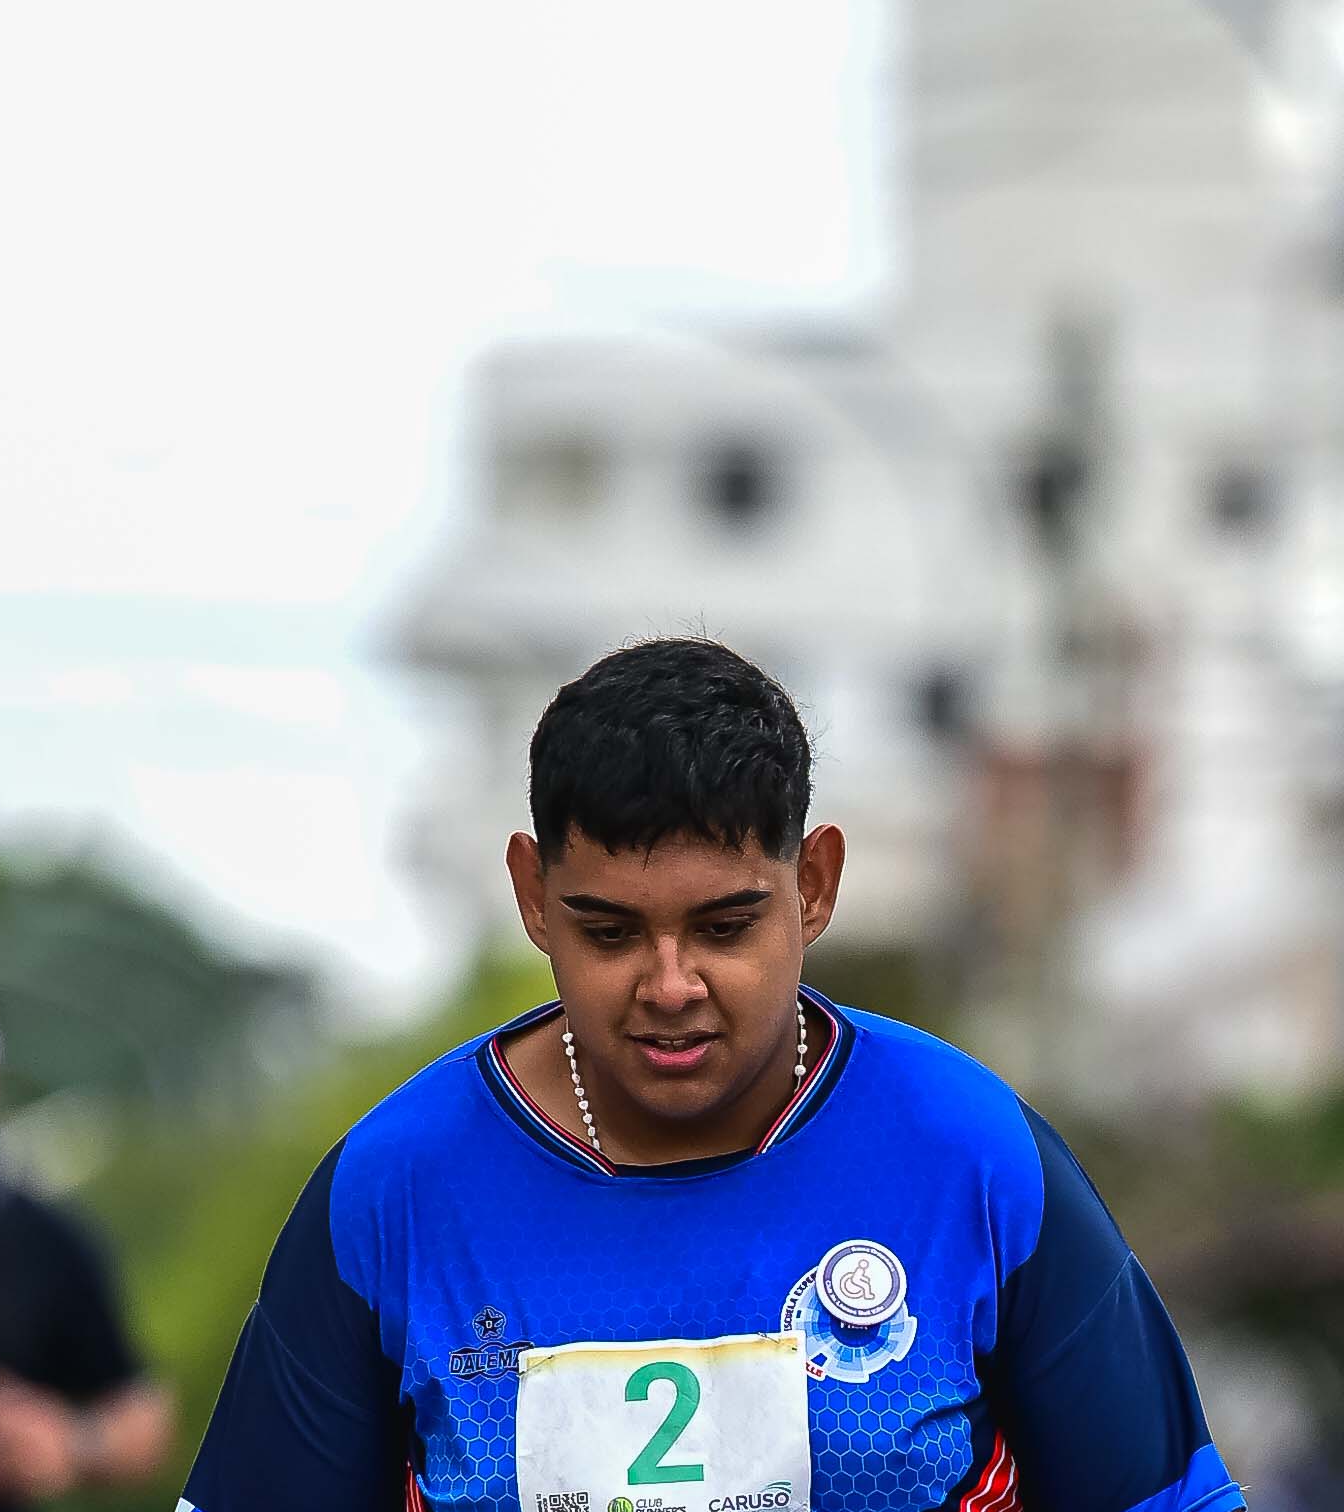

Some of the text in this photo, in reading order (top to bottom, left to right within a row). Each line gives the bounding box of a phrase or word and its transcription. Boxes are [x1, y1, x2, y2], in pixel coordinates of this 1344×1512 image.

[624, 1361, 704, 1485] 2
[635, 1497, 663, 1509] CLUB
[708, 1491, 790, 1512] CARUSO
